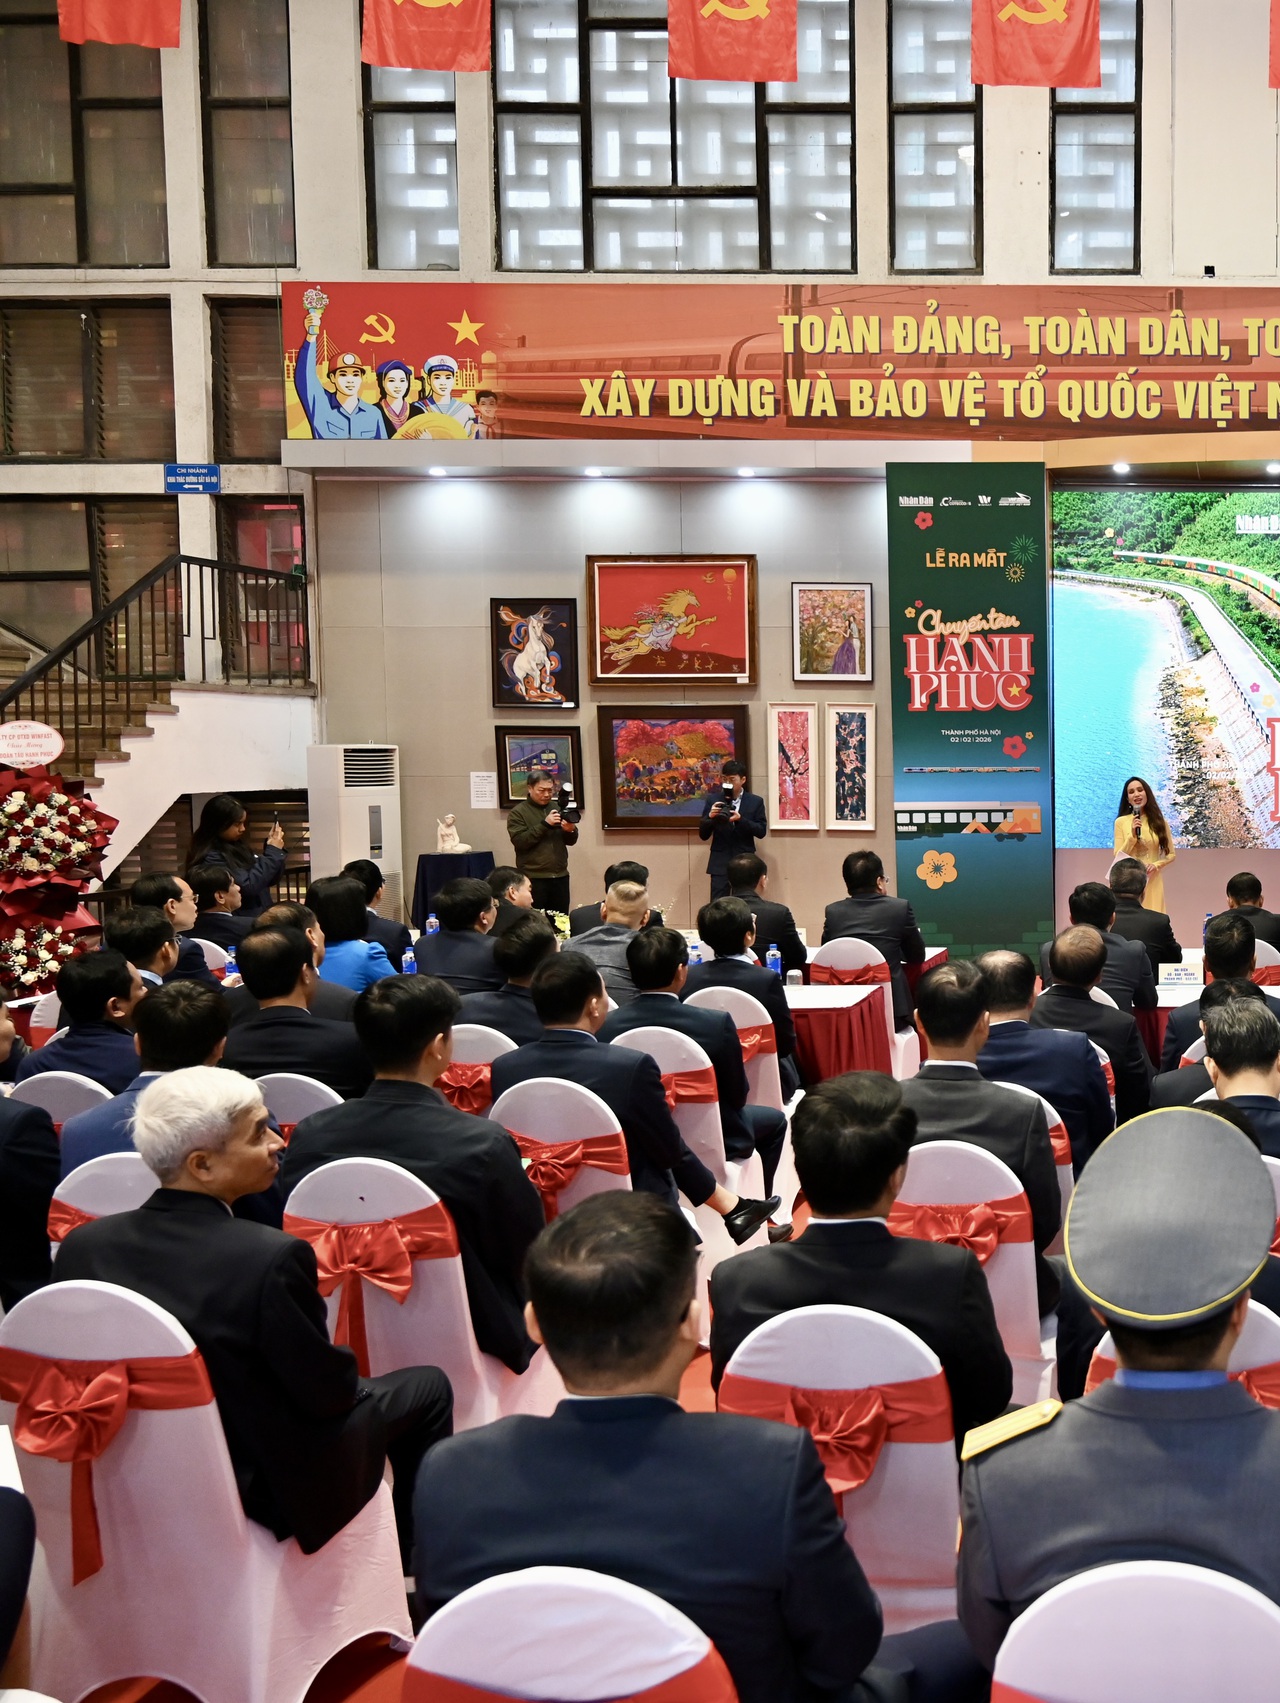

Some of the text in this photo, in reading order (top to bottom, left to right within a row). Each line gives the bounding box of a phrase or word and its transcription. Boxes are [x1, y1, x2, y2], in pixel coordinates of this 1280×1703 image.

[779, 307, 881, 354] TOÀN
[892, 300, 1012, 360] ĐẢNG,
[1024, 309, 1126, 356] TOÀN
[1140, 310, 1231, 361] DÂN,
[581, 371, 656, 417] XÂY
[669, 375, 776, 426] DỰNG
[787, 371, 839, 417] VÀ
[850, 363, 928, 418] BẢO
[940, 372, 987, 427] VỆ
[999, 365, 1047, 418] TỔ
[1059, 367, 1162, 423] QUỐC
[1174, 374, 1256, 428] VIỆT
[925, 547, 946, 568] LỄ
[948, 552, 971, 568] RA
[906, 637, 1032, 673] HẠNH
[911, 671, 1029, 709] PHÚC
